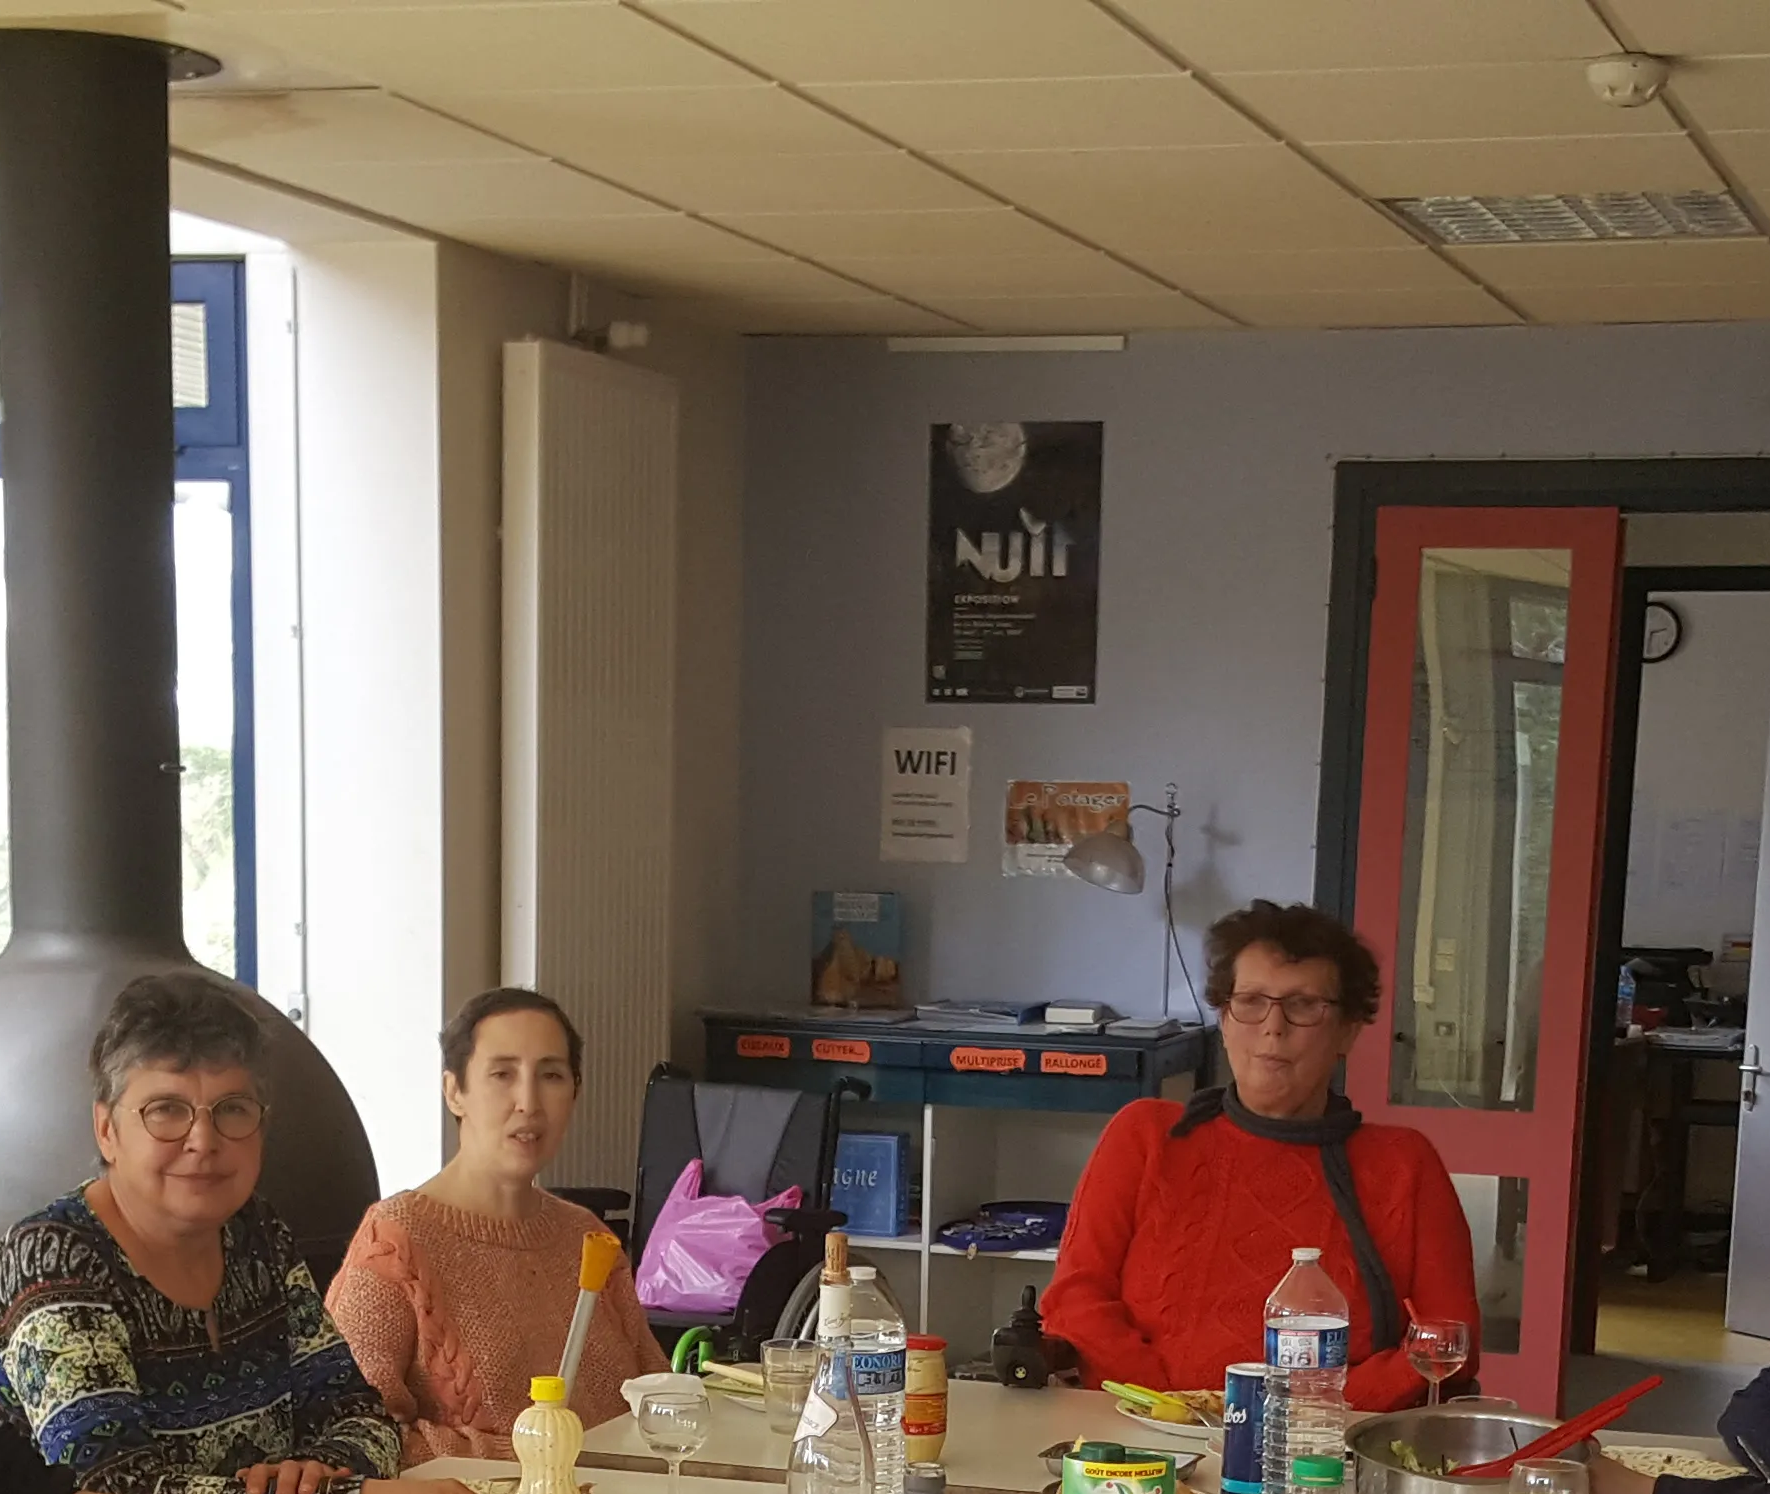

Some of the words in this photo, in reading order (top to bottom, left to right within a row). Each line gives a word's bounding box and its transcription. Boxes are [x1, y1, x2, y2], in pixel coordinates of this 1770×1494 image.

[956, 507, 1077, 583] NUIT
[895, 750, 956, 776] WIFI
[1042, 783, 1127, 813] Potager
[956, 1054, 1020, 1068] MULTIPRISE
[1045, 1057, 1102, 1070] RALLONGE
